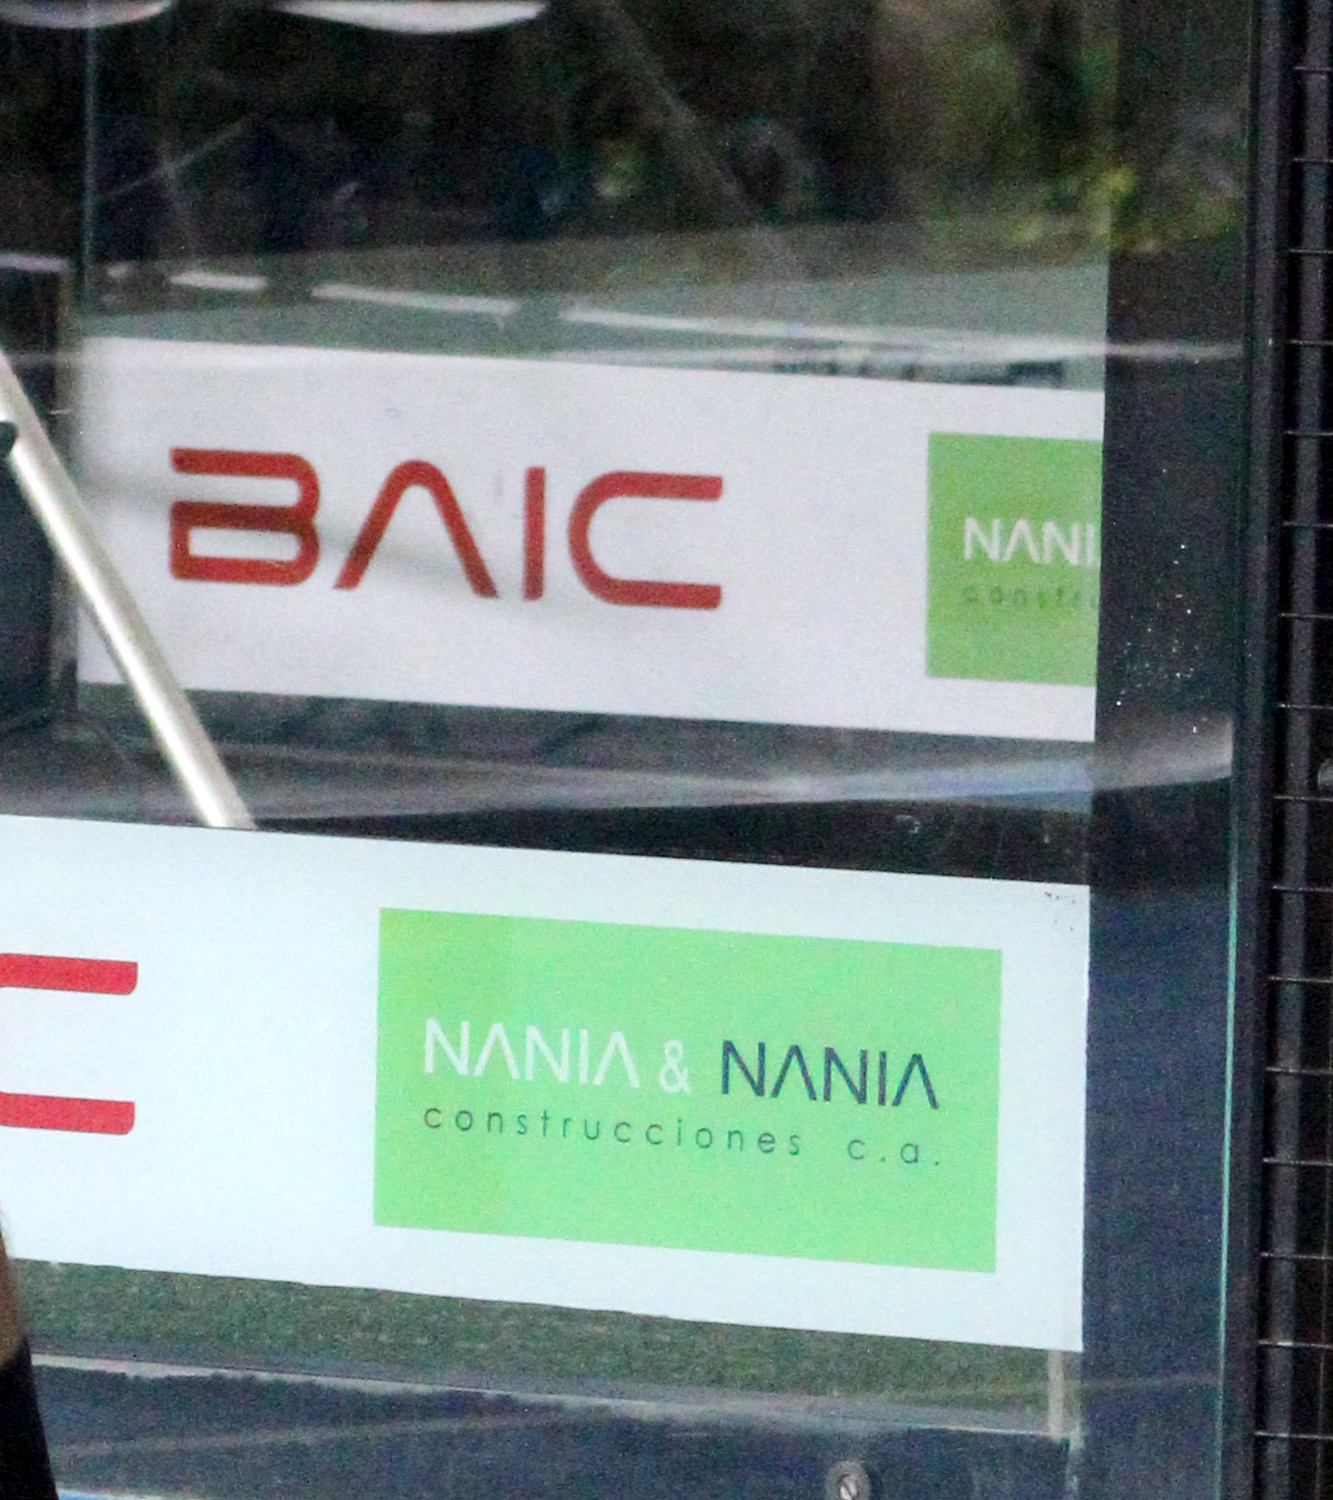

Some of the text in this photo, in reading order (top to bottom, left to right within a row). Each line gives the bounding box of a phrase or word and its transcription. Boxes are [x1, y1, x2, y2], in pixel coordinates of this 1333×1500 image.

[169, 447, 723, 610] BAIC
[424, 1017, 940, 1110] NANIA & NANIA
[423, 1105, 801, 1157] construcciones
